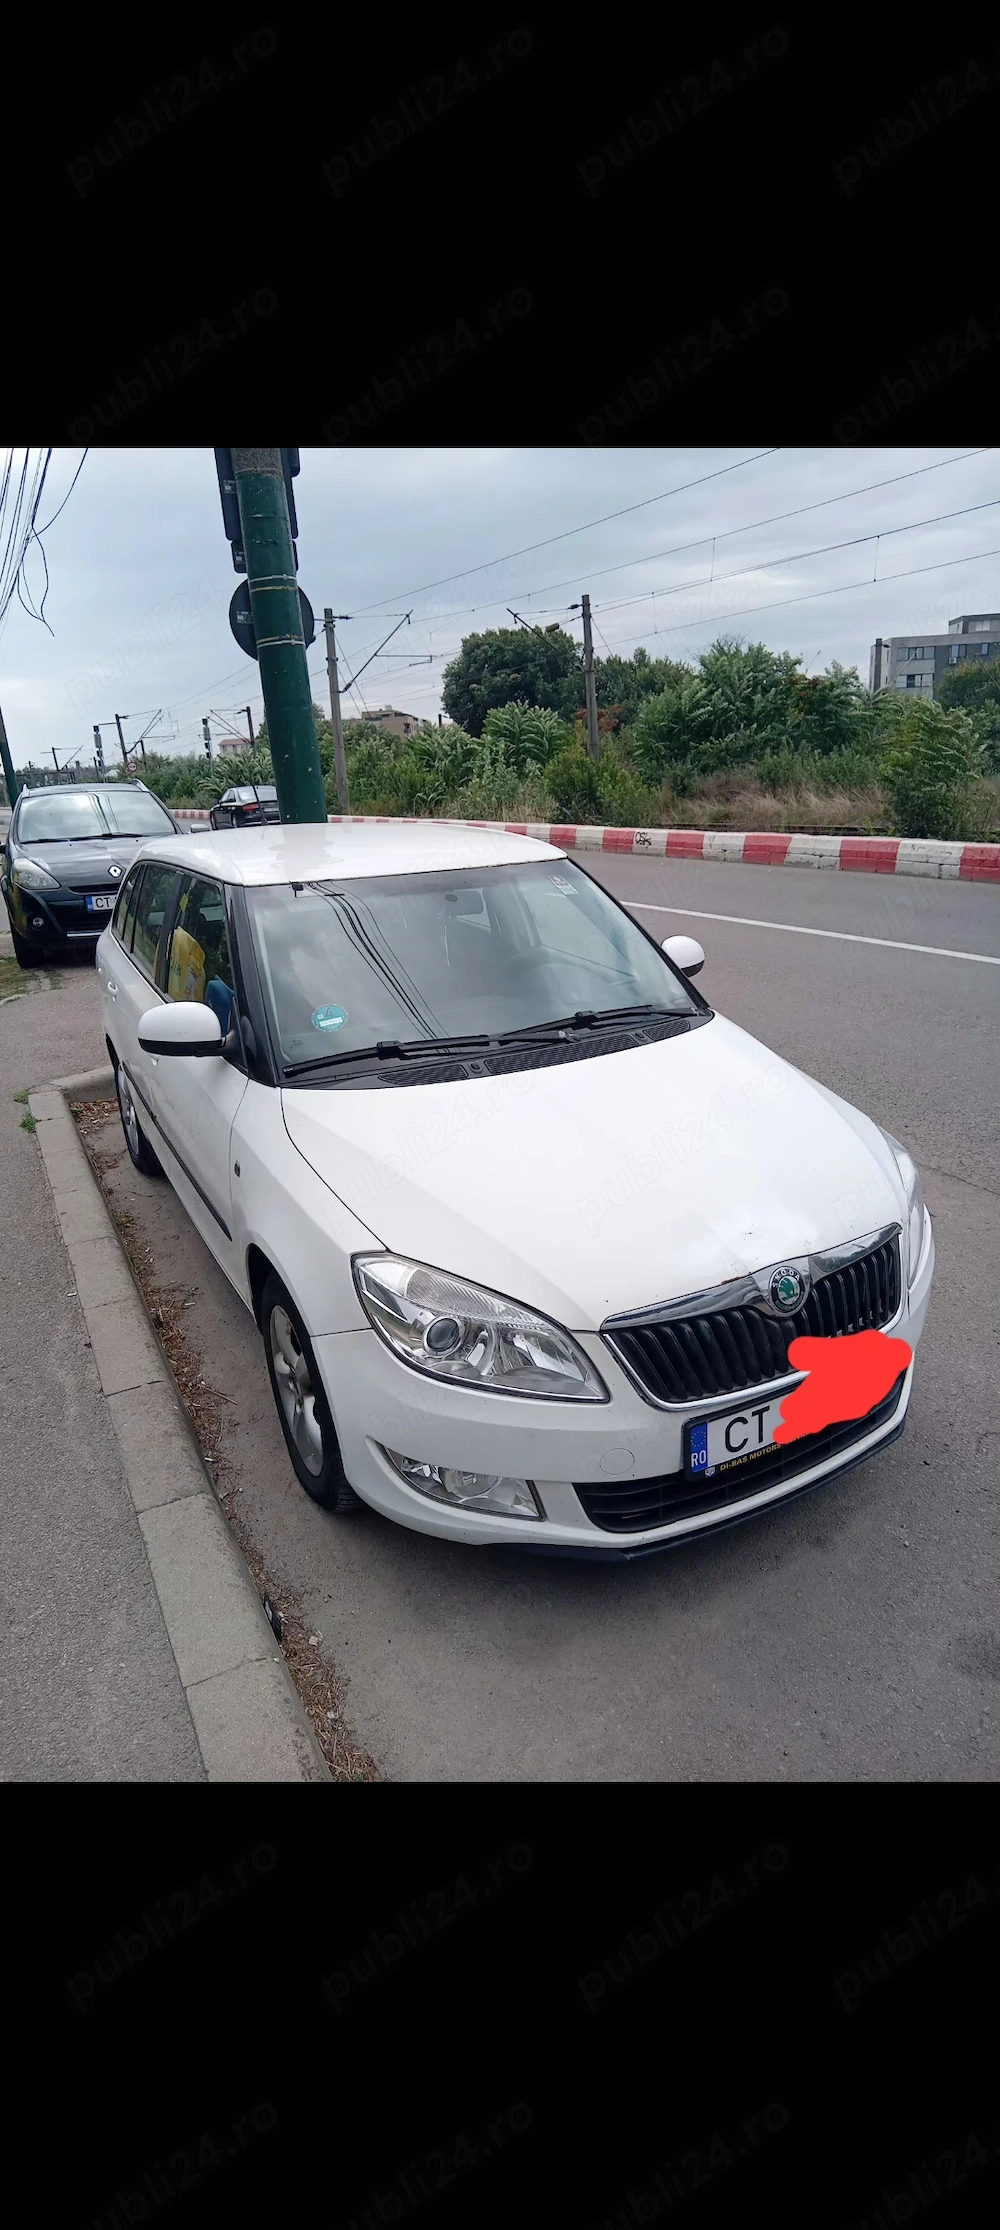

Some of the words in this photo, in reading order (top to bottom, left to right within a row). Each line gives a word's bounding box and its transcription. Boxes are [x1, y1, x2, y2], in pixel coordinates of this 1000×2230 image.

[95, 897, 110, 909] CT
[725, 1405, 770, 1453] CT
[690, 1449, 707, 1468] RO
[720, 1455, 748, 1471] DI-BAS
[749, 1443, 781, 1460] MOTORS
